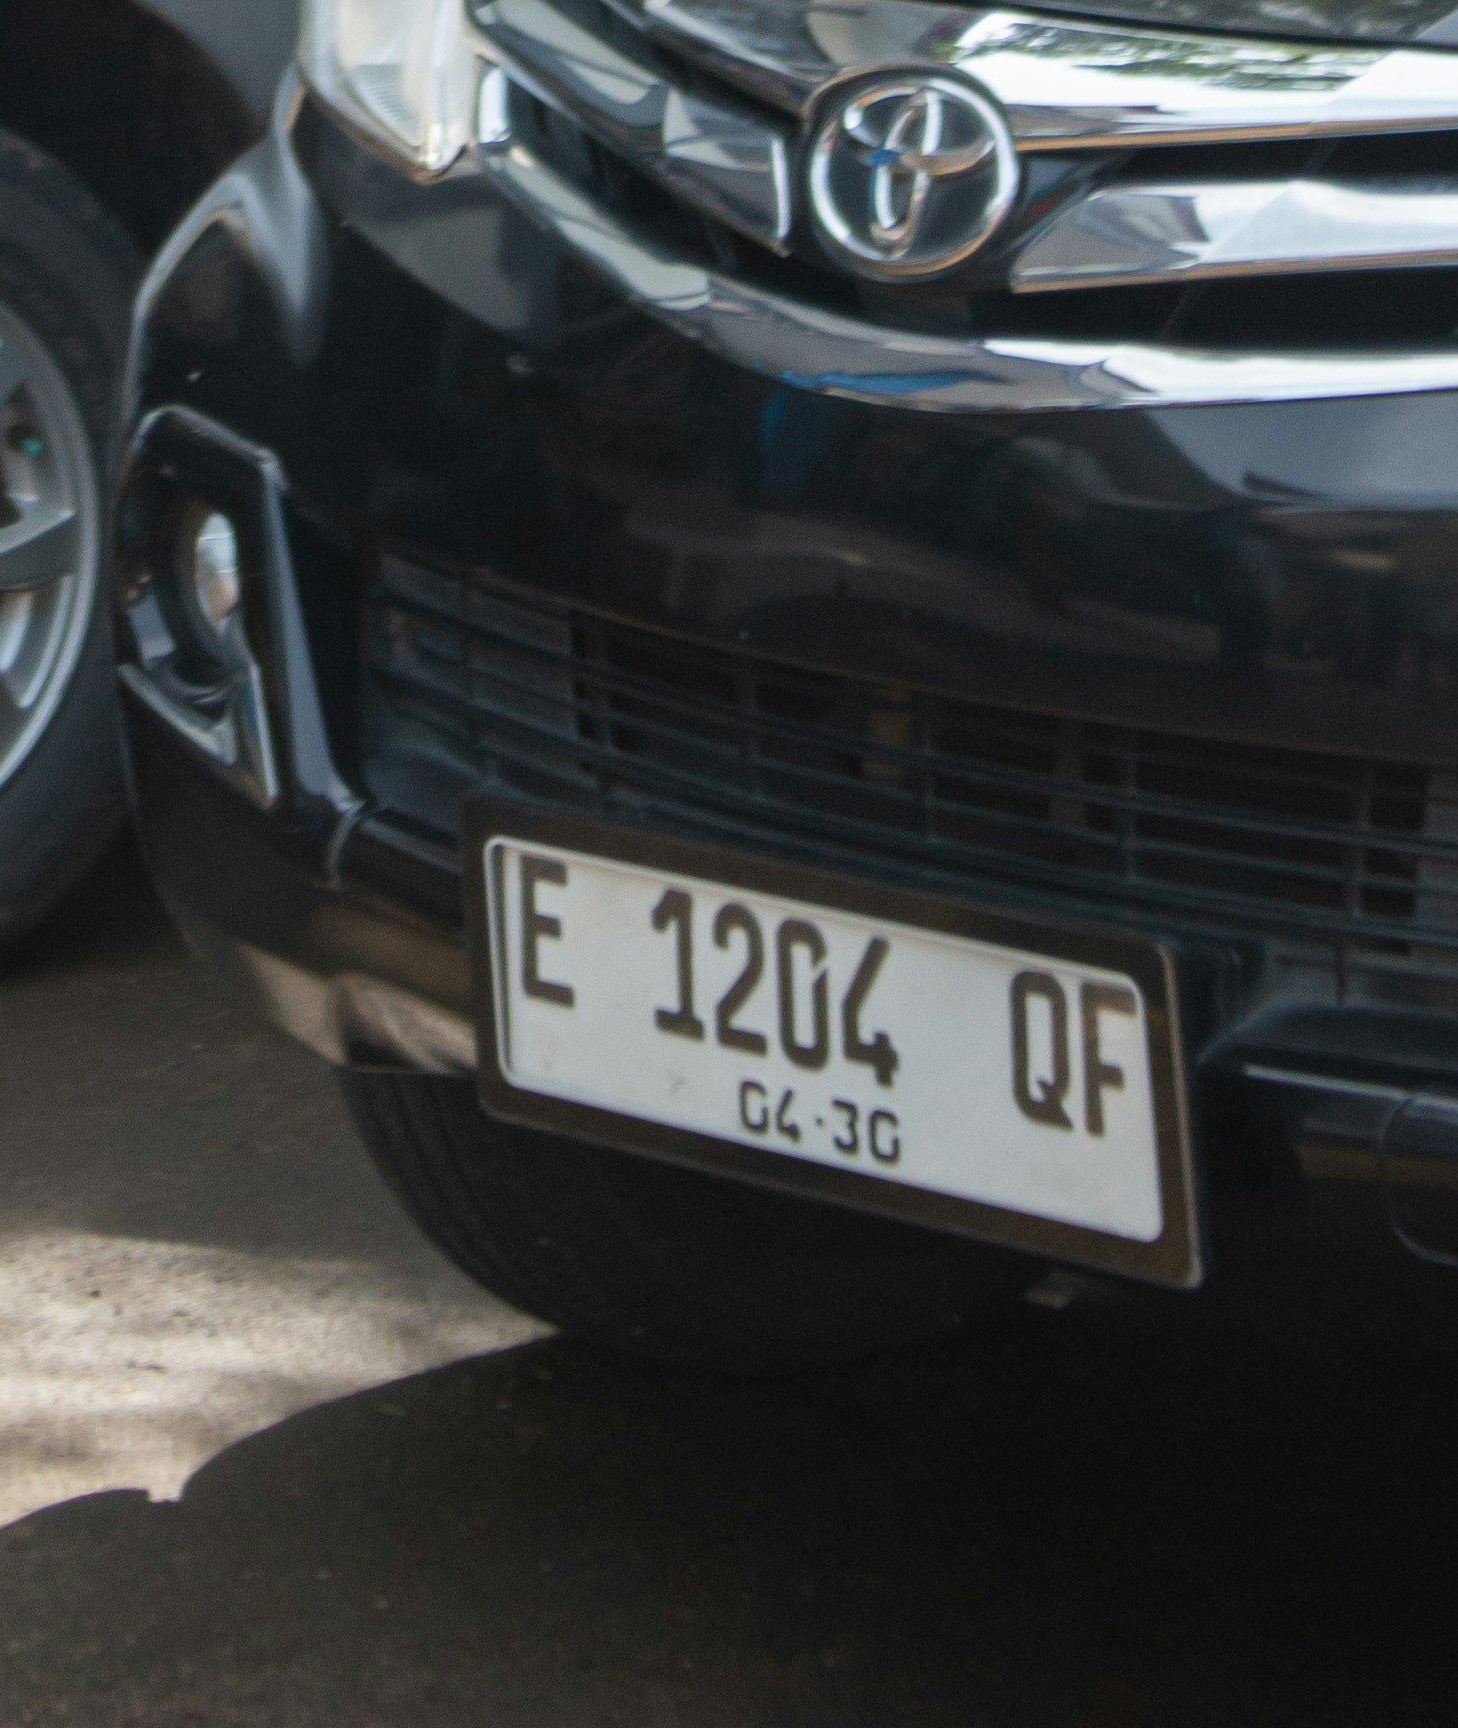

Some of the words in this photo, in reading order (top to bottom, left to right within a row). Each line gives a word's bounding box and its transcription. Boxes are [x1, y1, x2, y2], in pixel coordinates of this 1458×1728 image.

[517, 852, 575, 1009] E
[650, 888, 900, 1088] 1204
[1009, 969, 1139, 1139] QF
